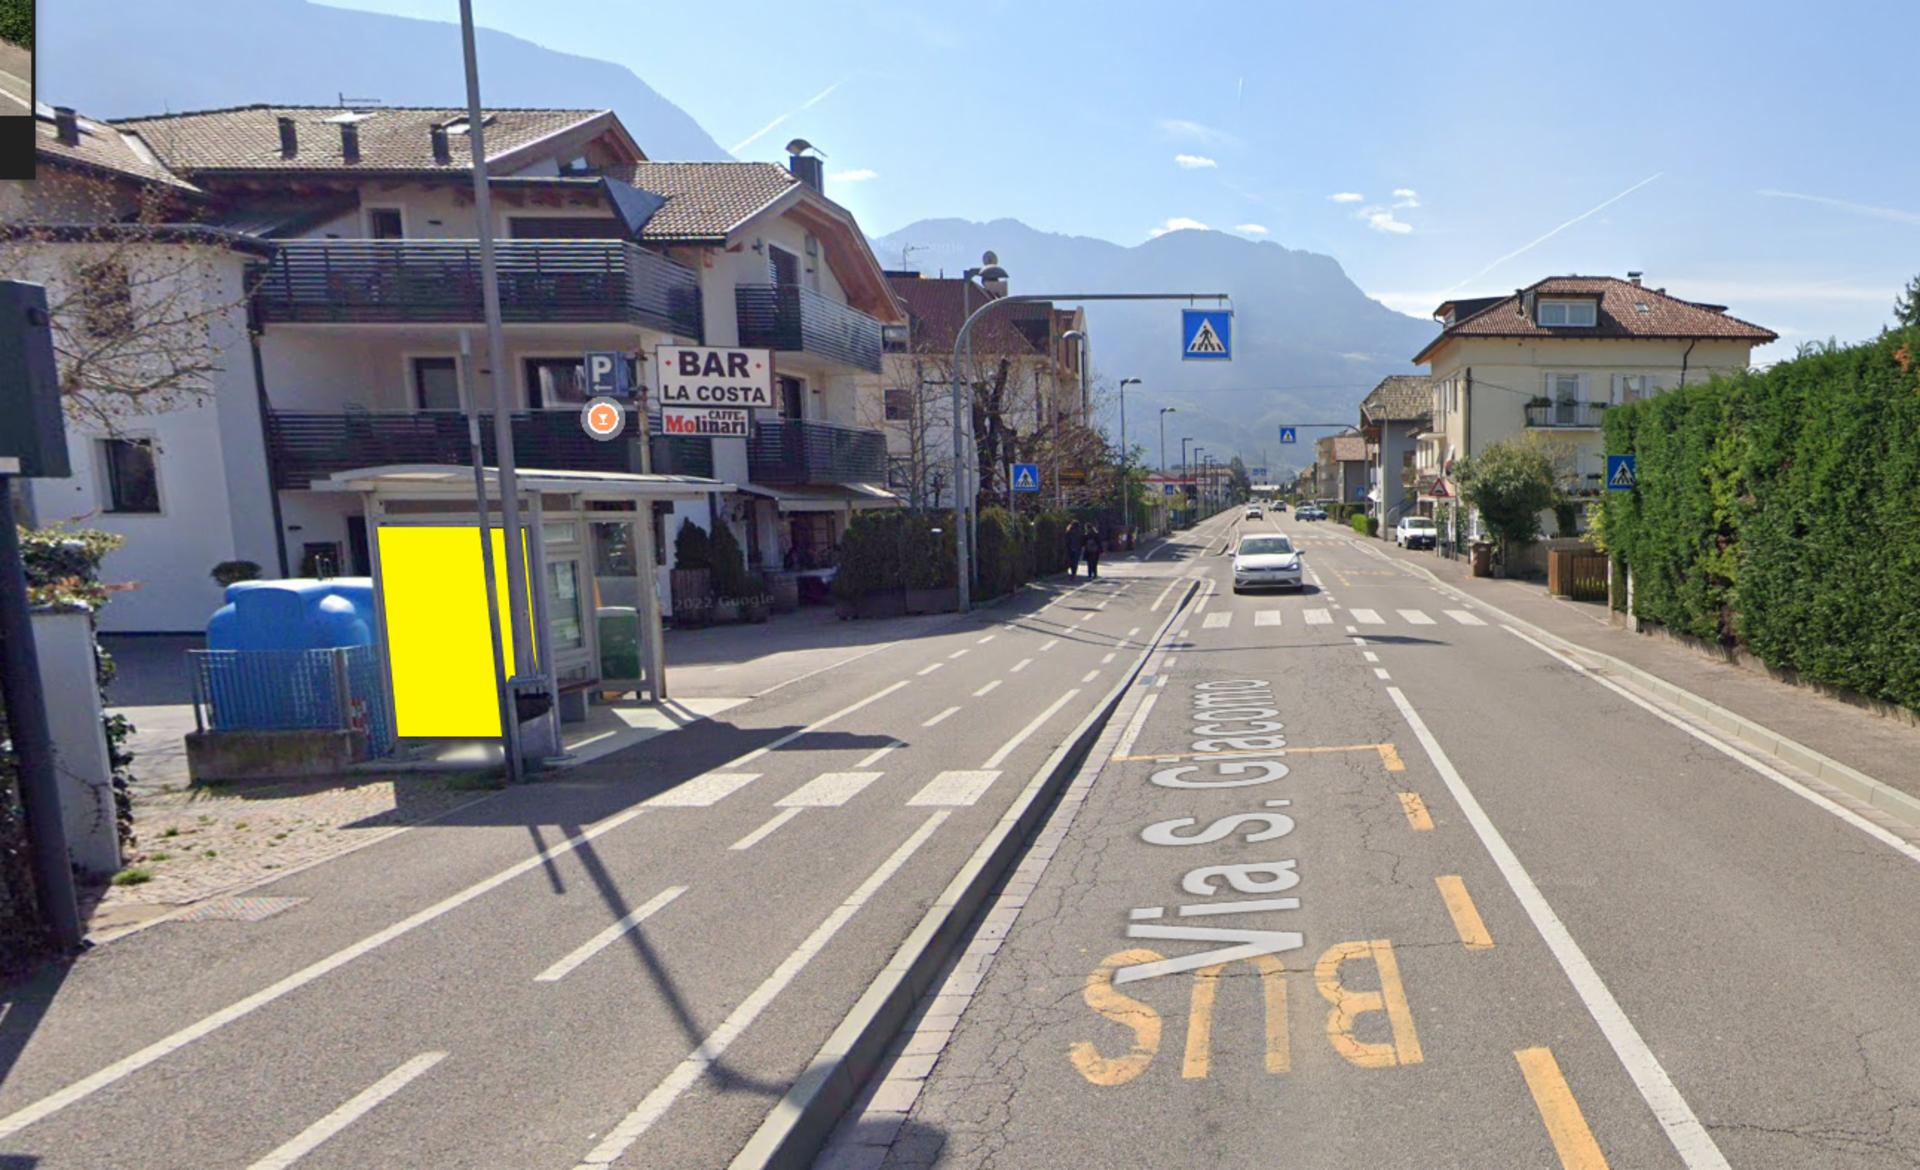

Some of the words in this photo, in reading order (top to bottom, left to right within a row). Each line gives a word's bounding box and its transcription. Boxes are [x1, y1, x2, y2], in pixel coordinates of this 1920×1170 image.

[592, 355, 612, 383] P
[678, 350, 750, 378] BAR
[663, 384, 690, 401] LA
[696, 385, 766, 403] COSTA
[665, 414, 746, 434] Molinari
[1070, 939, 1425, 1086] BUS
